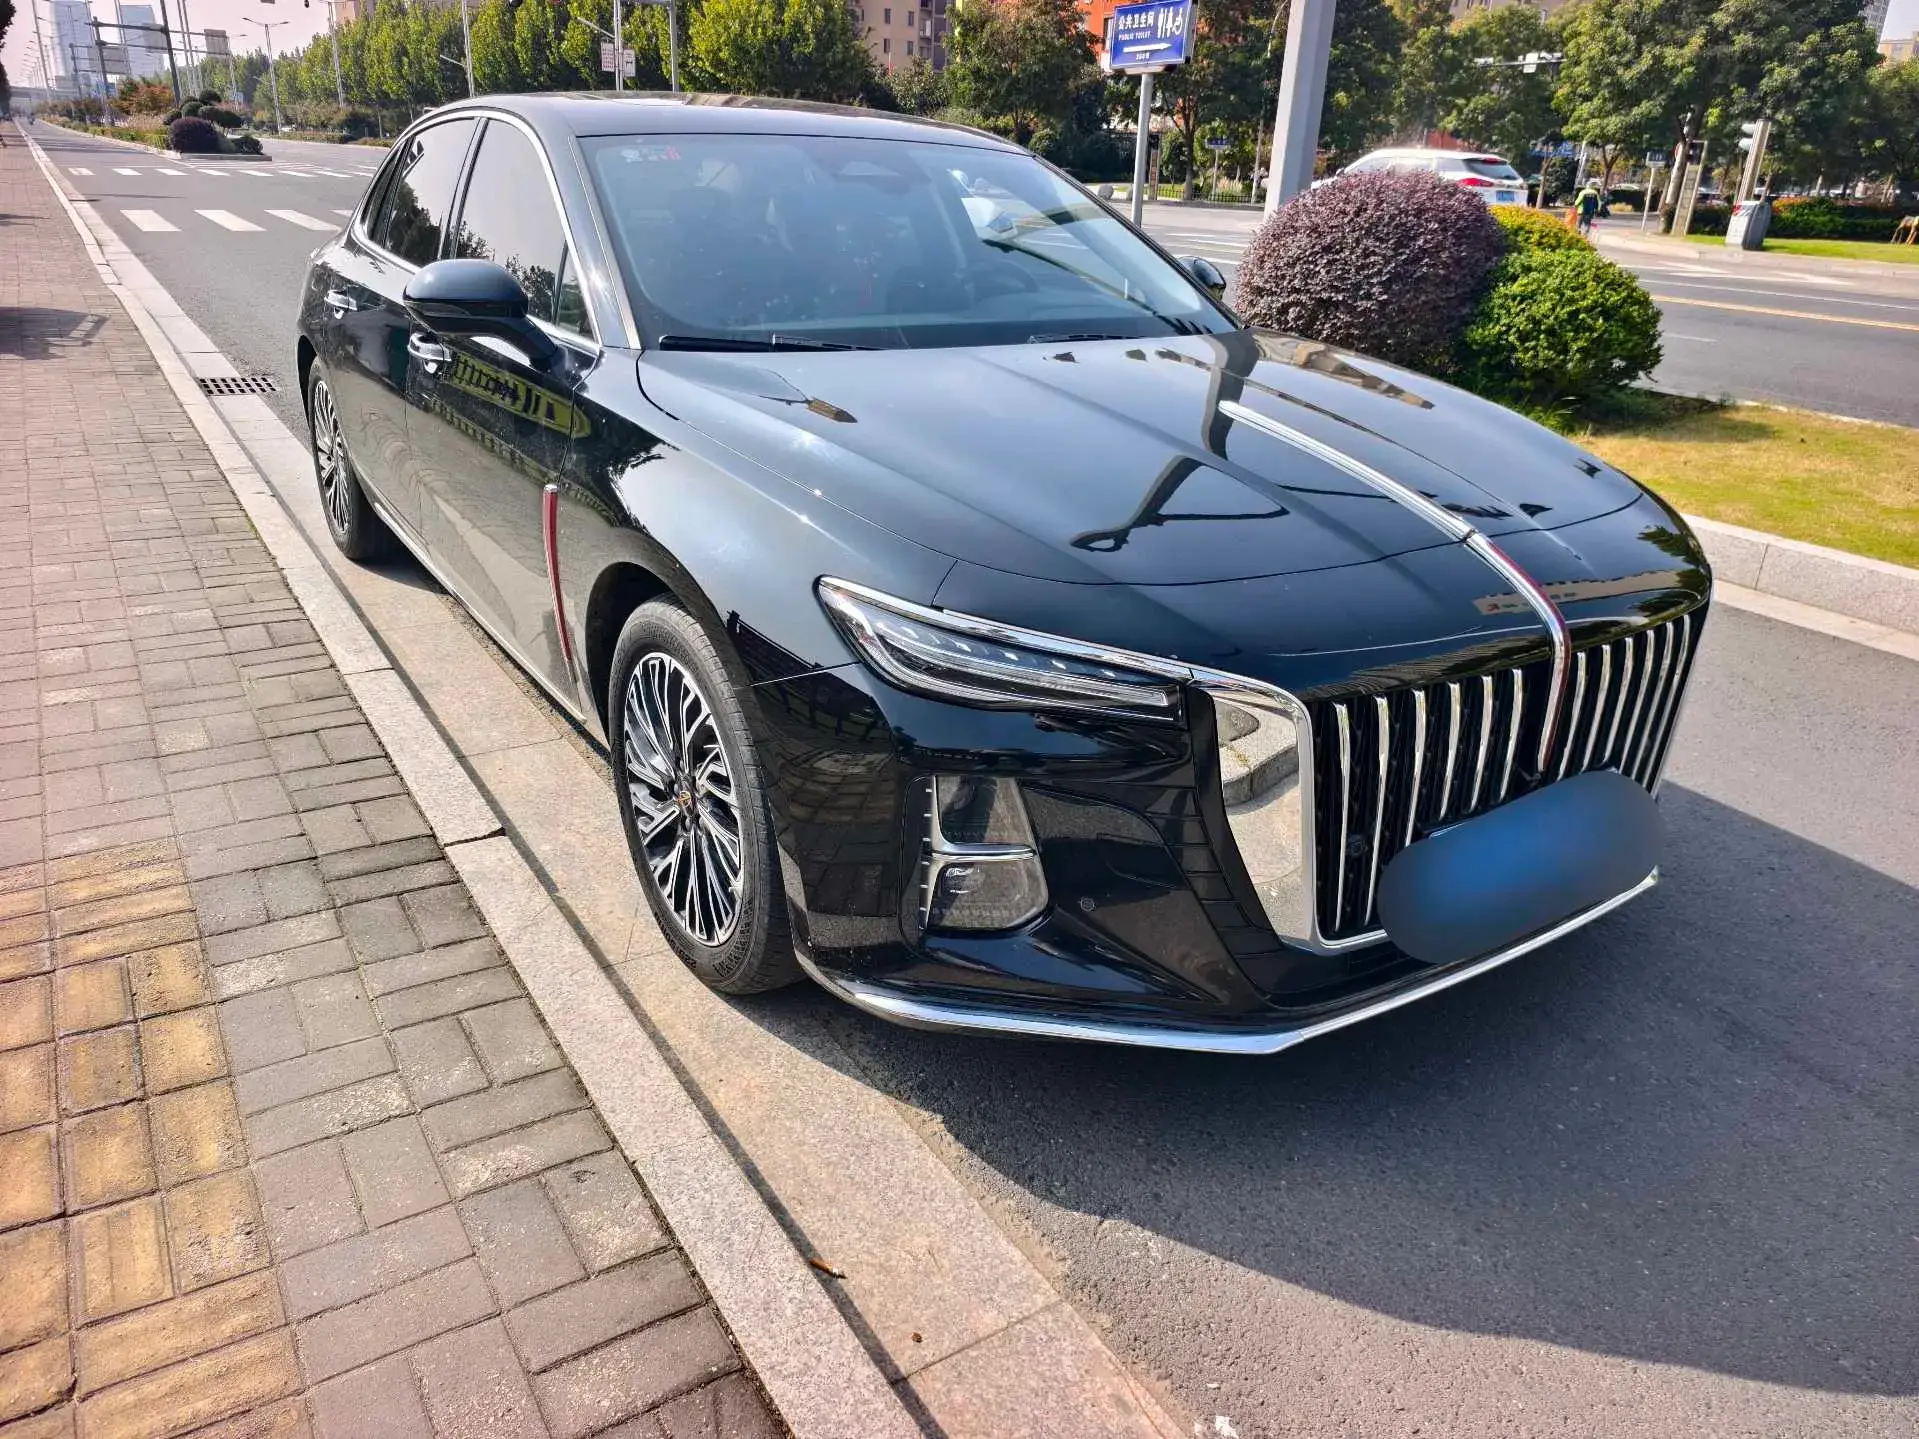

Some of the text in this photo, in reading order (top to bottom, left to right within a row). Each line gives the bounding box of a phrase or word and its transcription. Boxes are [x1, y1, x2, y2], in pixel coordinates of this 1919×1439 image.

[1118, 11, 1155, 30] 公共卫生间
